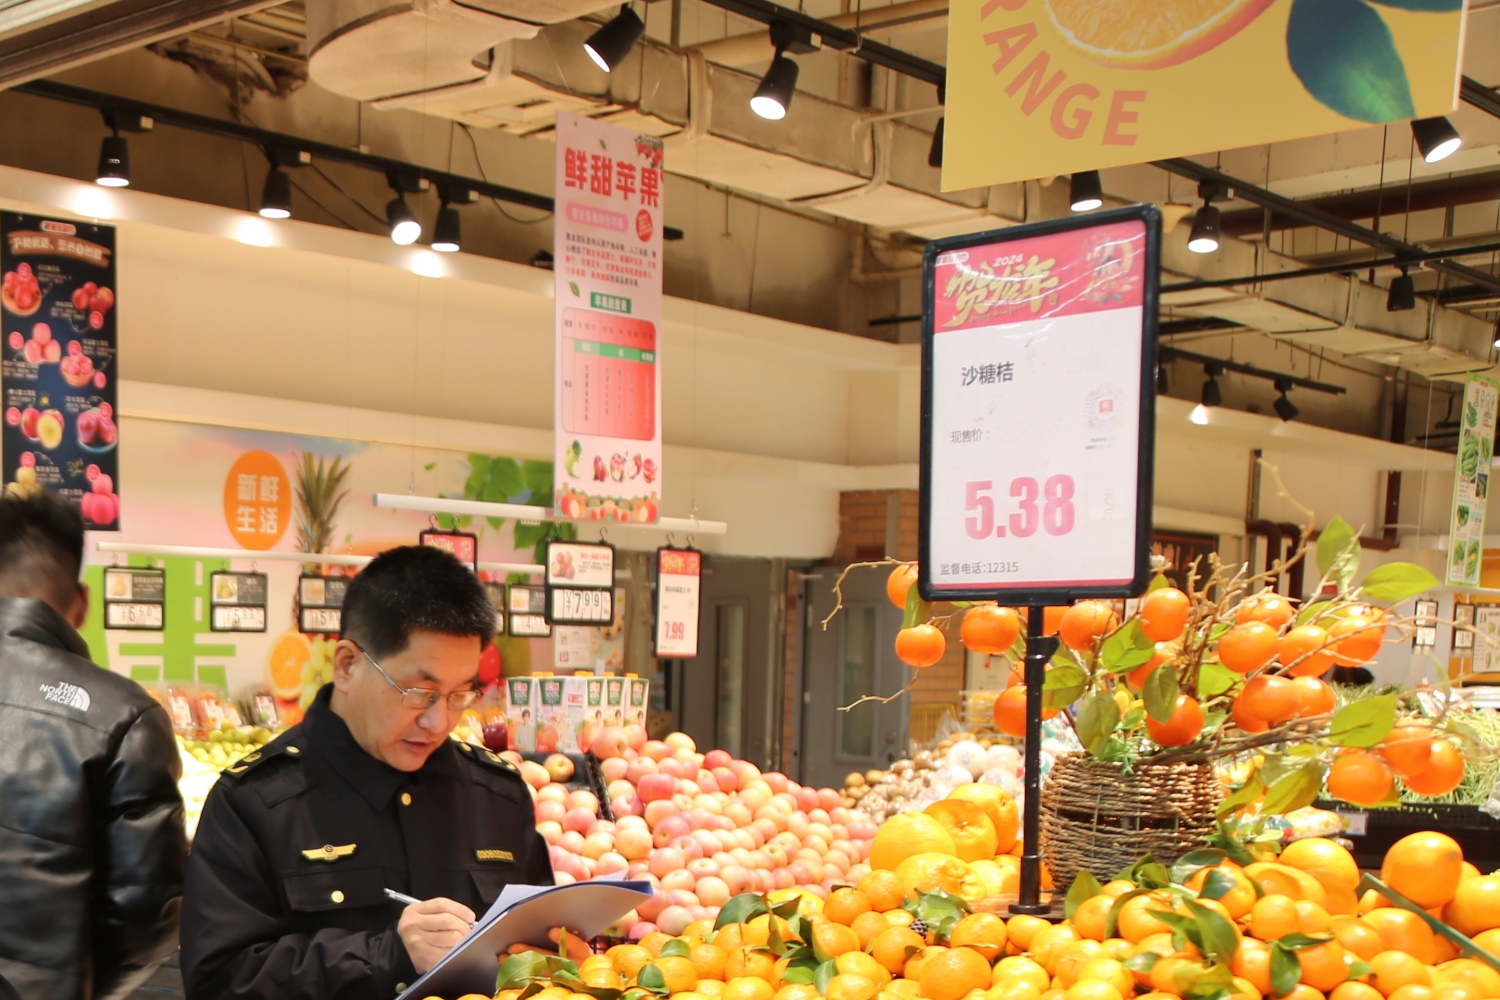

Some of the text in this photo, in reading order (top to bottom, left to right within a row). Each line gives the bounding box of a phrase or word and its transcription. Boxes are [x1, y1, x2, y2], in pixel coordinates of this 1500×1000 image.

[564, 146, 660, 208] 鲜甜苹果
[993, 253, 1024, 268] 2024
[961, 360, 1014, 387] 沙糖桔
[236, 471, 281, 504] 新鲜
[965, 473, 1076, 540] 5.38
[236, 506, 279, 536] 生活
[940, 561, 1019, 576] 监督电话:12315
[665, 620, 684, 641] 7.99
[39, 683, 75, 699] NORTH
[59, 681, 79, 693] THE
[44, 691, 71, 706] FACE
